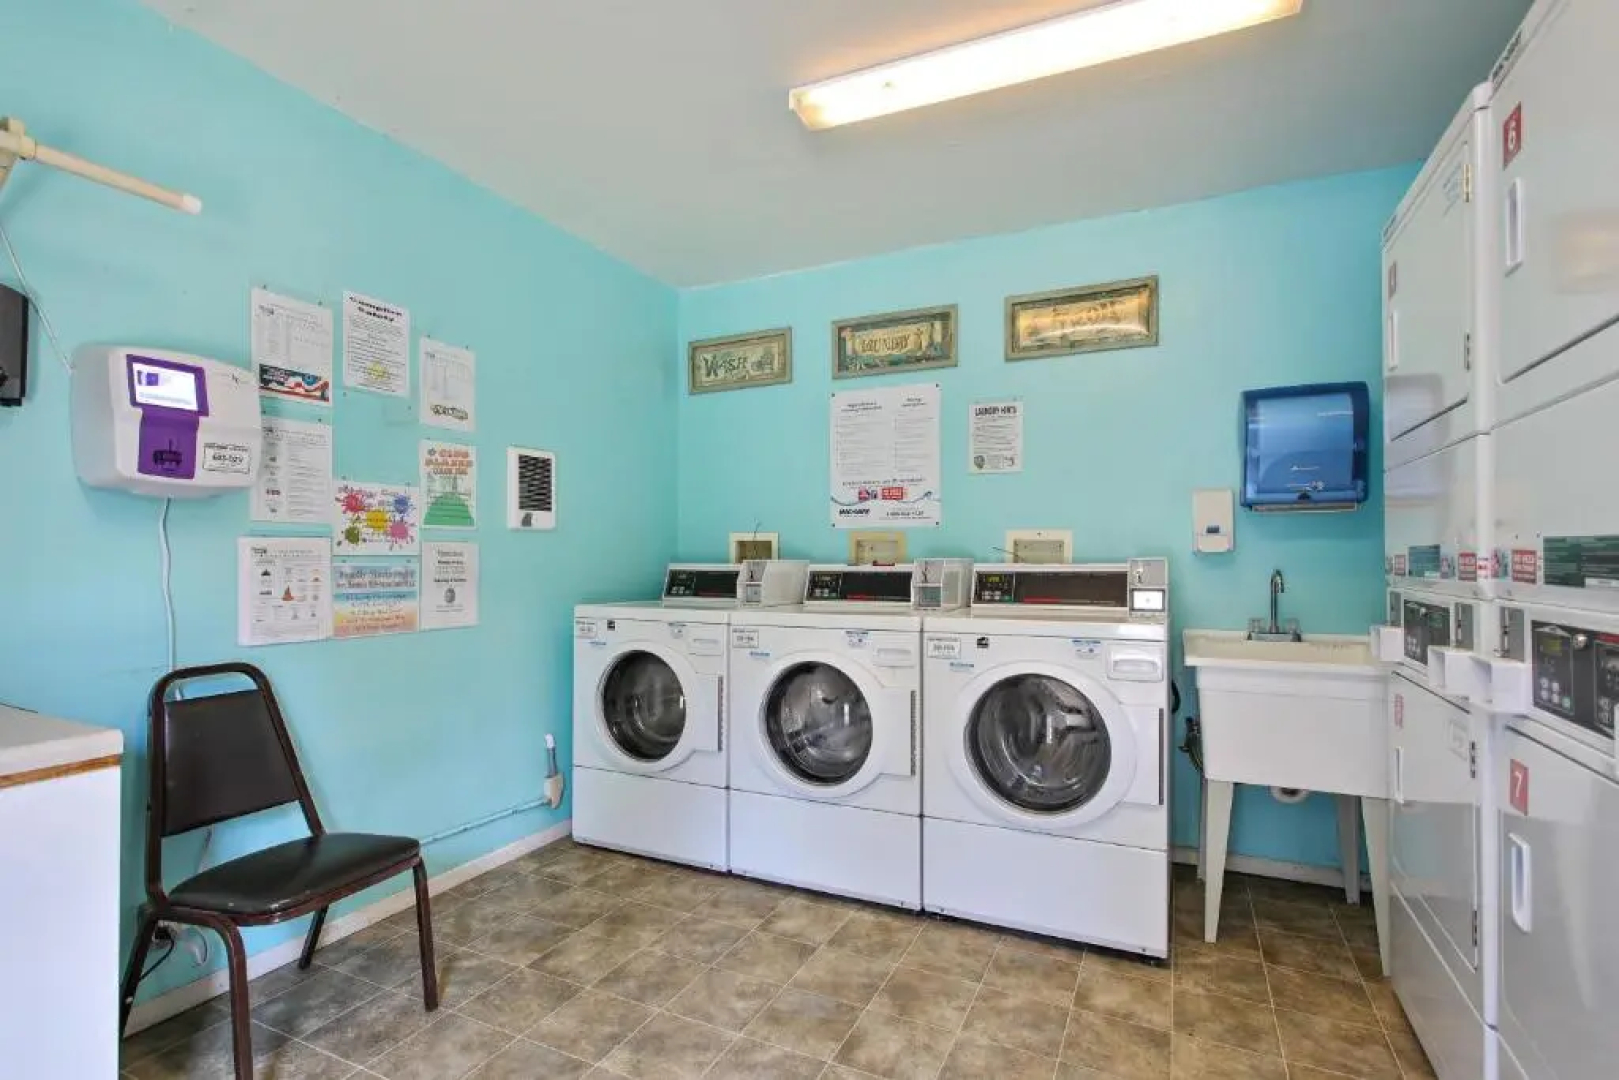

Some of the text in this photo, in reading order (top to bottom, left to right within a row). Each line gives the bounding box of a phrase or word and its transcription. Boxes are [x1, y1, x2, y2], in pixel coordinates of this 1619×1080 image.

[1508, 118, 1516, 151] 6
[975, 406, 1000, 417] LAUNDRY
[1514, 771, 1522, 798] 7
